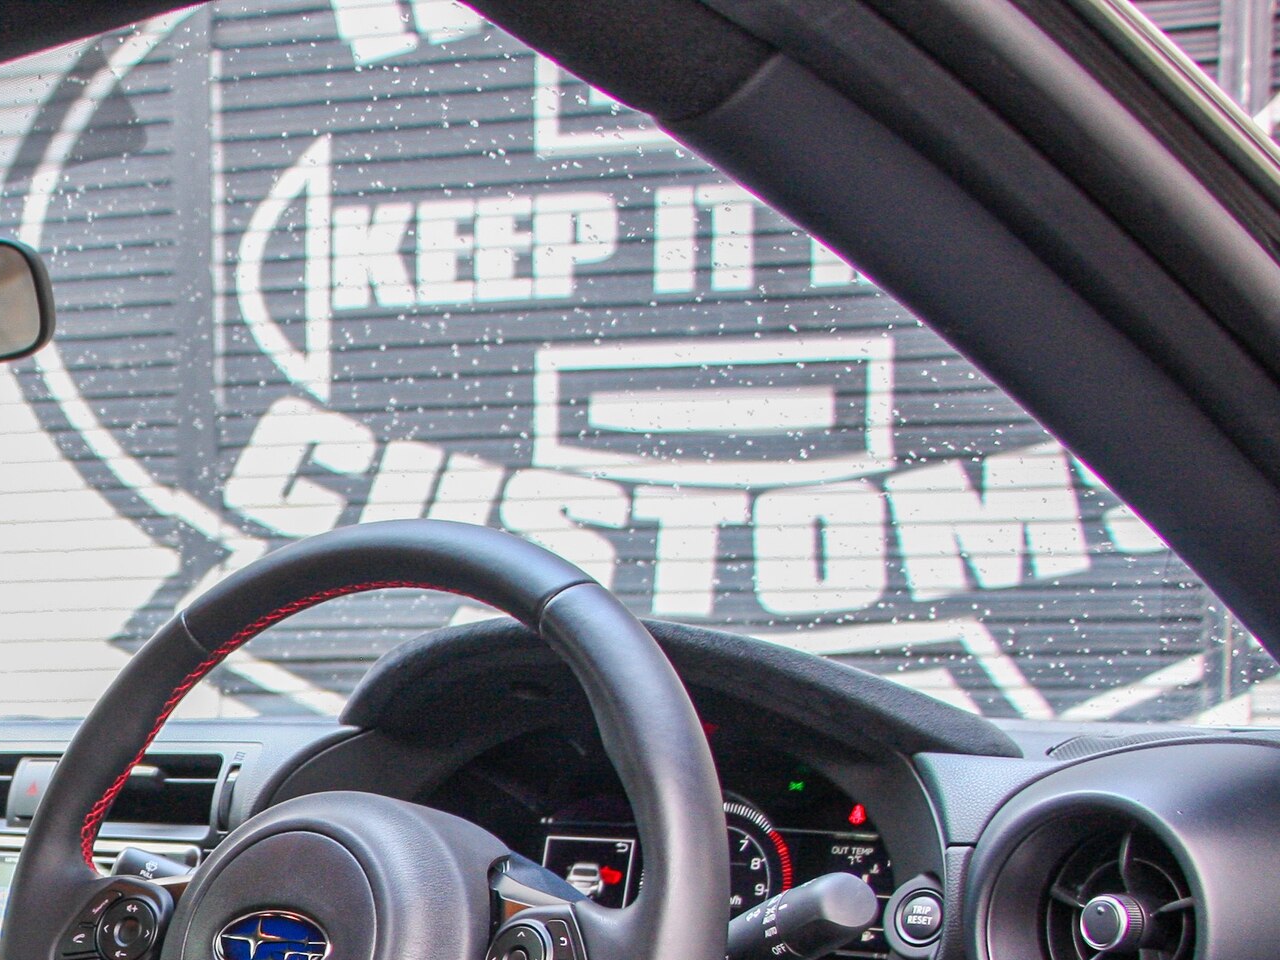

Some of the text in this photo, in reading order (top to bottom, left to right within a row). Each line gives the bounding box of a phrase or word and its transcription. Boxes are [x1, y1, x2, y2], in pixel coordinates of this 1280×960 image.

[331, 191, 617, 311] KEEP
[653, 184, 762, 294] IT
[224, 397, 1170, 620] CUSTOM
[739, 839, 750, 851] 7
[831, 846, 875, 856] OUT TEMP
[750, 857, 762, 870] 8
[754, 883, 765, 896] 9
[912, 905, 932, 915] TRIP
[907, 915, 933, 926] RESET
[771, 943, 787, 955] OFF
